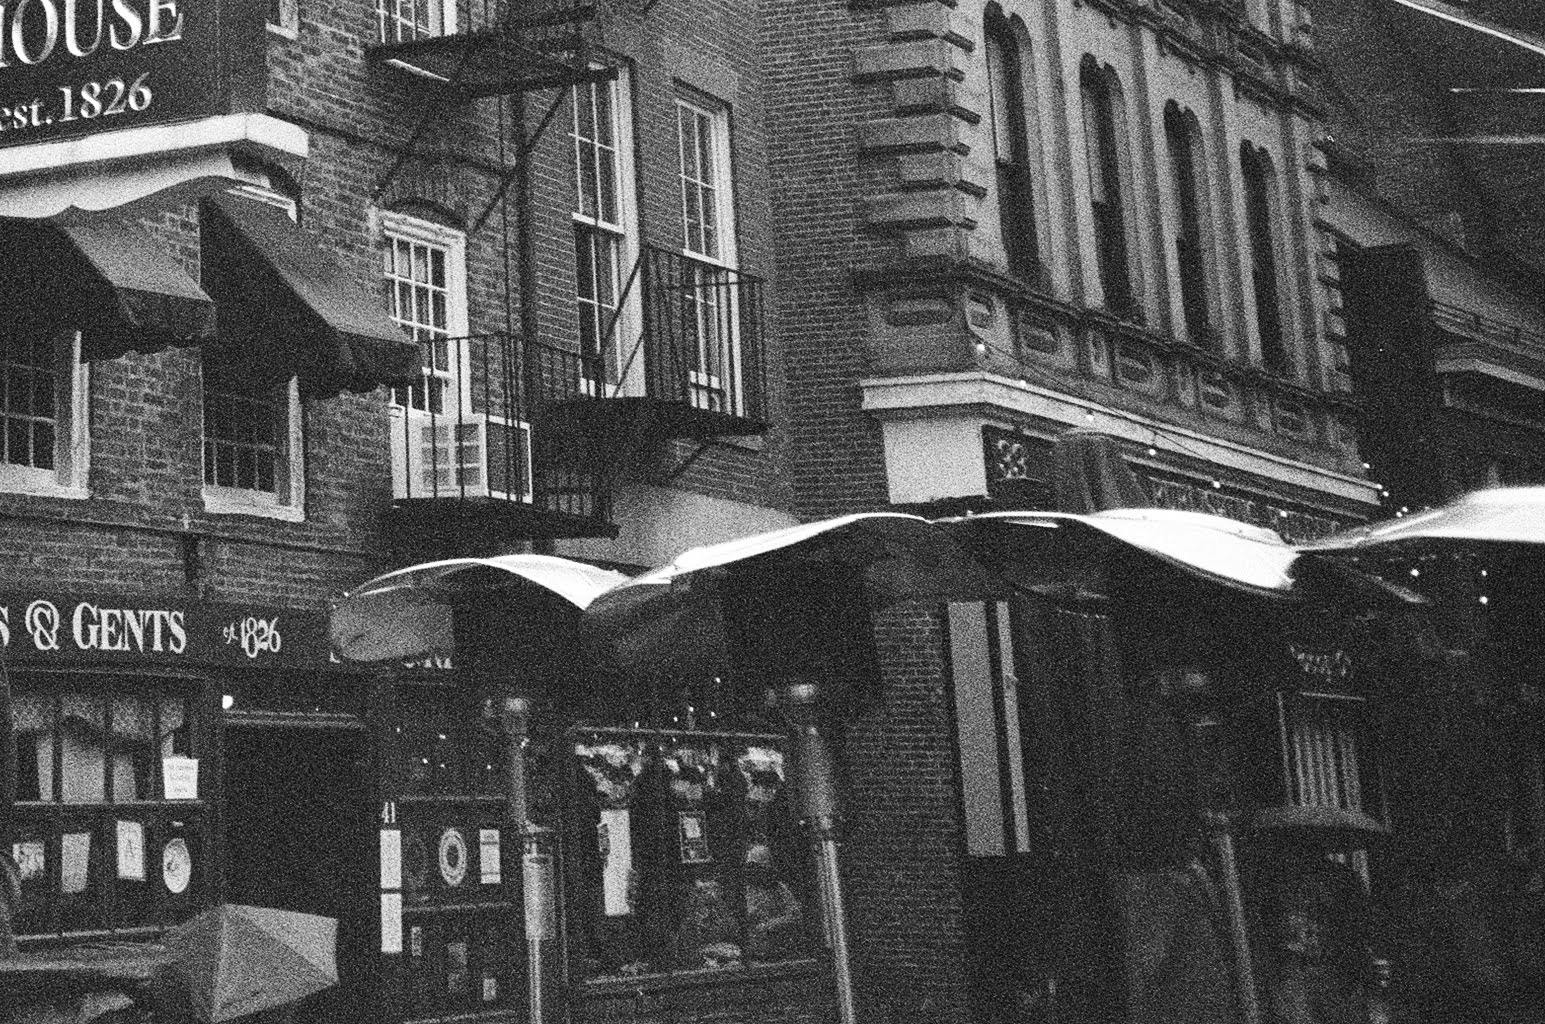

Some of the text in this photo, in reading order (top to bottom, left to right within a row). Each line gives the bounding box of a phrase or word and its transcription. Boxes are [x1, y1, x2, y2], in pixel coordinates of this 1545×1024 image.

[57, 71, 153, 122] 1826
[24, 598, 61, 651] &
[71, 601, 188, 655] GENTS
[240, 616, 282, 659] 1826
[381, 801, 396, 824] 41
